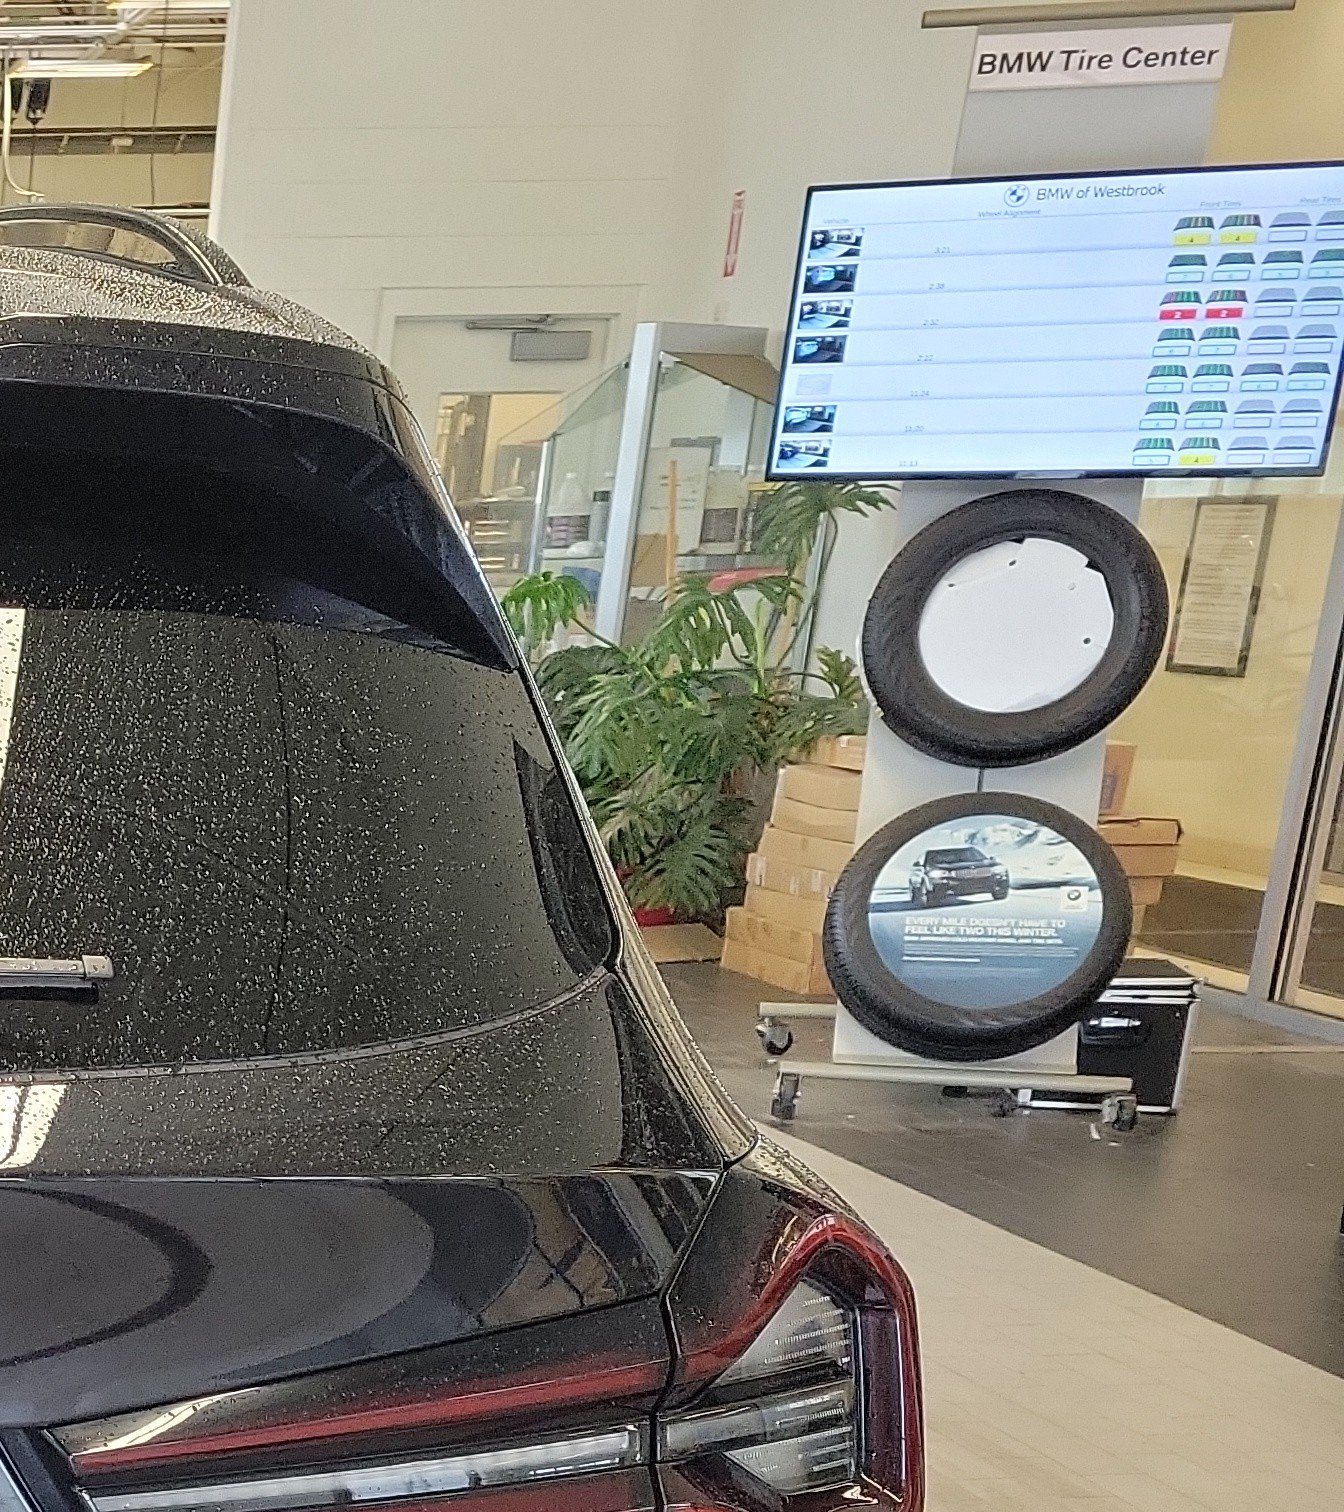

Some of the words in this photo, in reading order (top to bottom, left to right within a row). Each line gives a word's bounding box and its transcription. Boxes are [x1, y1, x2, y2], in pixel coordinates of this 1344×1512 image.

[977, 51, 1054, 76] BMW
[1060, 49, 1113, 72] Tire
[1122, 46, 1221, 70] Center
[1036, 187, 1074, 201] BMW
[1076, 186, 1091, 199] of
[1093, 182, 1167, 198] Westbrook
[905, 916, 939, 926] EVERY
[1051, 918, 1066, 928] TO
[904, 925, 931, 935] FEEL
[933, 926, 958, 935] LIKE
[960, 926, 985, 936] TWO
[986, 927, 1012, 936] THIS
